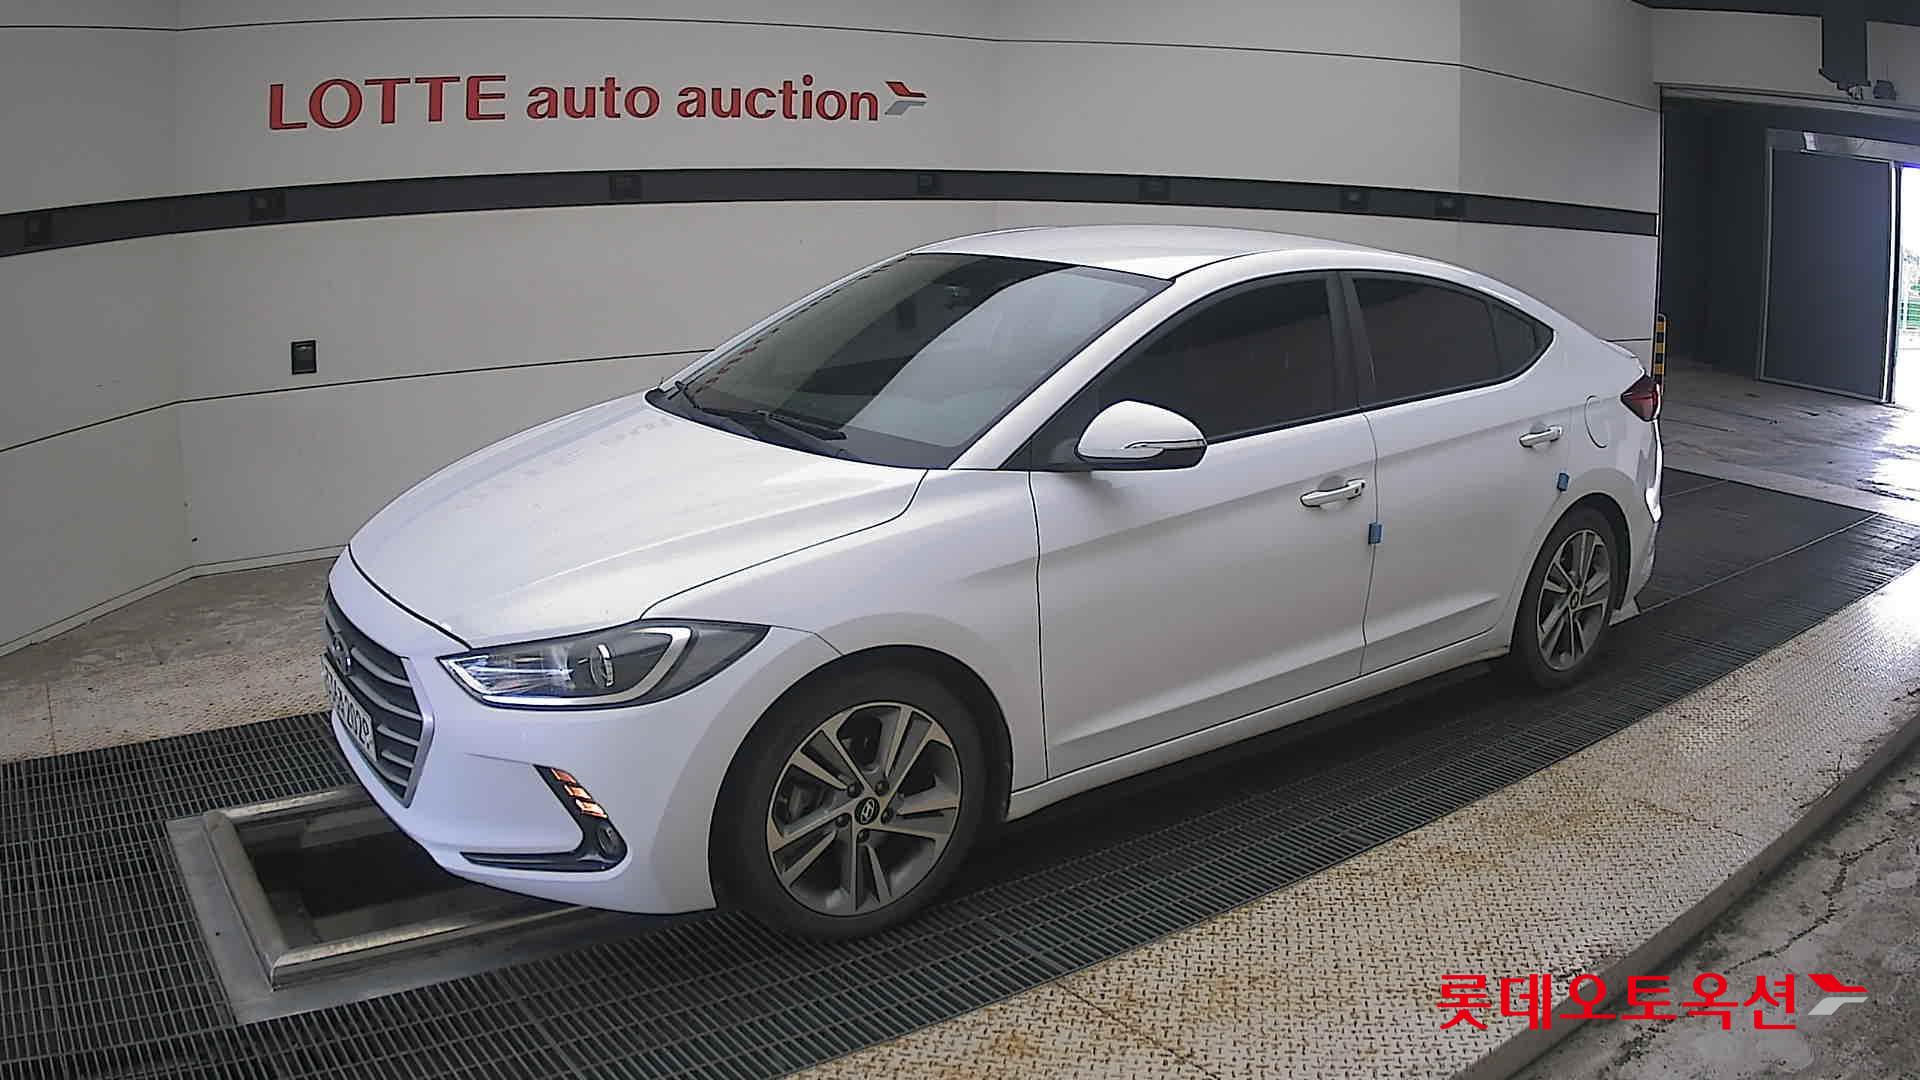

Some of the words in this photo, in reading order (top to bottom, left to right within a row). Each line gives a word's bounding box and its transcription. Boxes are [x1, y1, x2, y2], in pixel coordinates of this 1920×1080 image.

[270, 76, 506, 130] LOTTE
[527, 78, 660, 119] auto
[678, 75, 879, 120] auction
